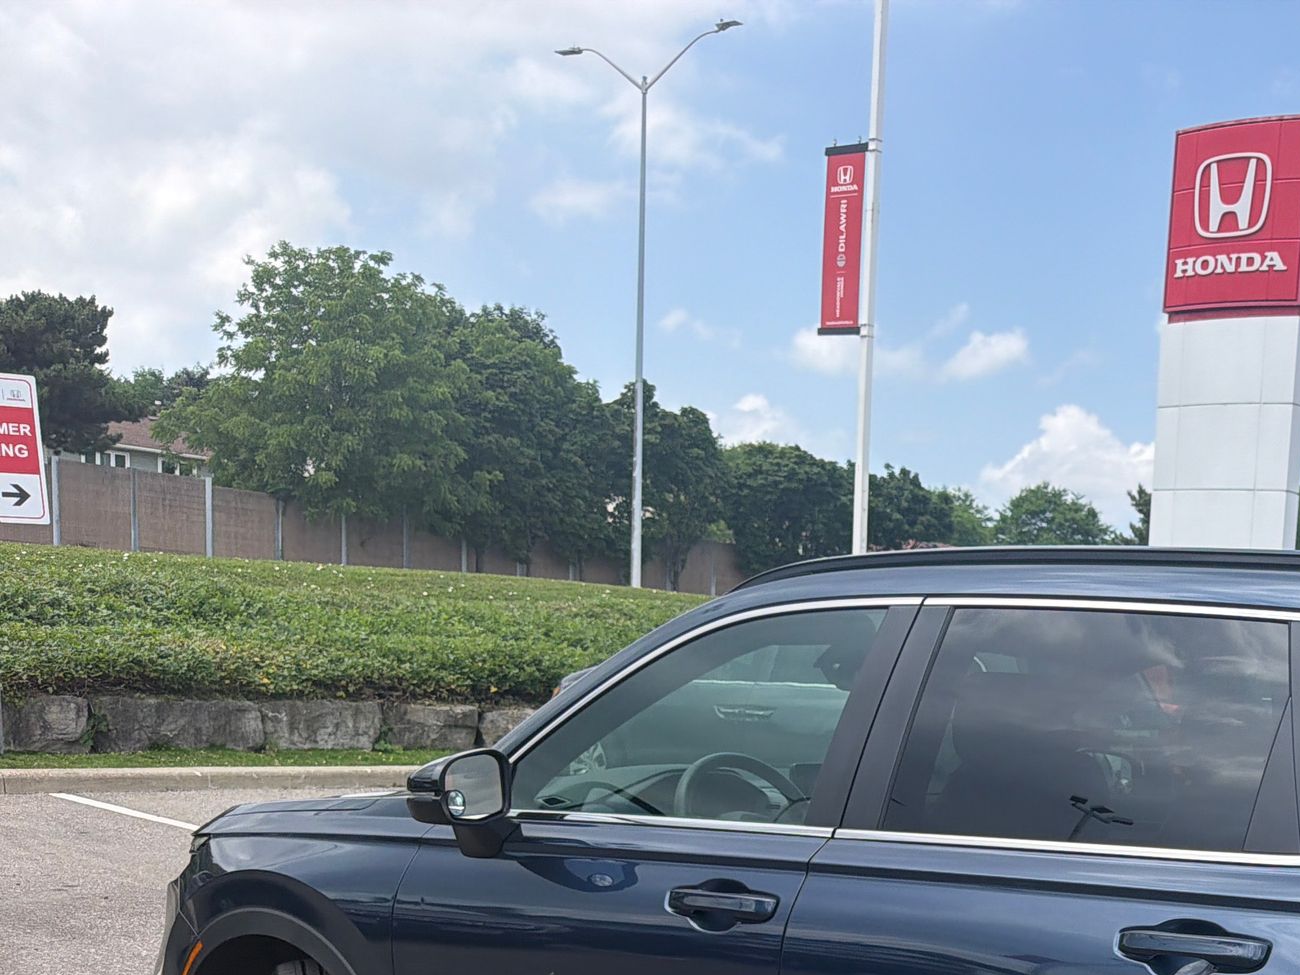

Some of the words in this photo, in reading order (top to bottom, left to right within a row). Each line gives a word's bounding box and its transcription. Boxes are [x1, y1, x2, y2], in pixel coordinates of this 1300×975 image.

[838, 200, 848, 252] DILAWRI
[1174, 252, 1287, 278] HONDA
[0, 443, 29, 458] NG
